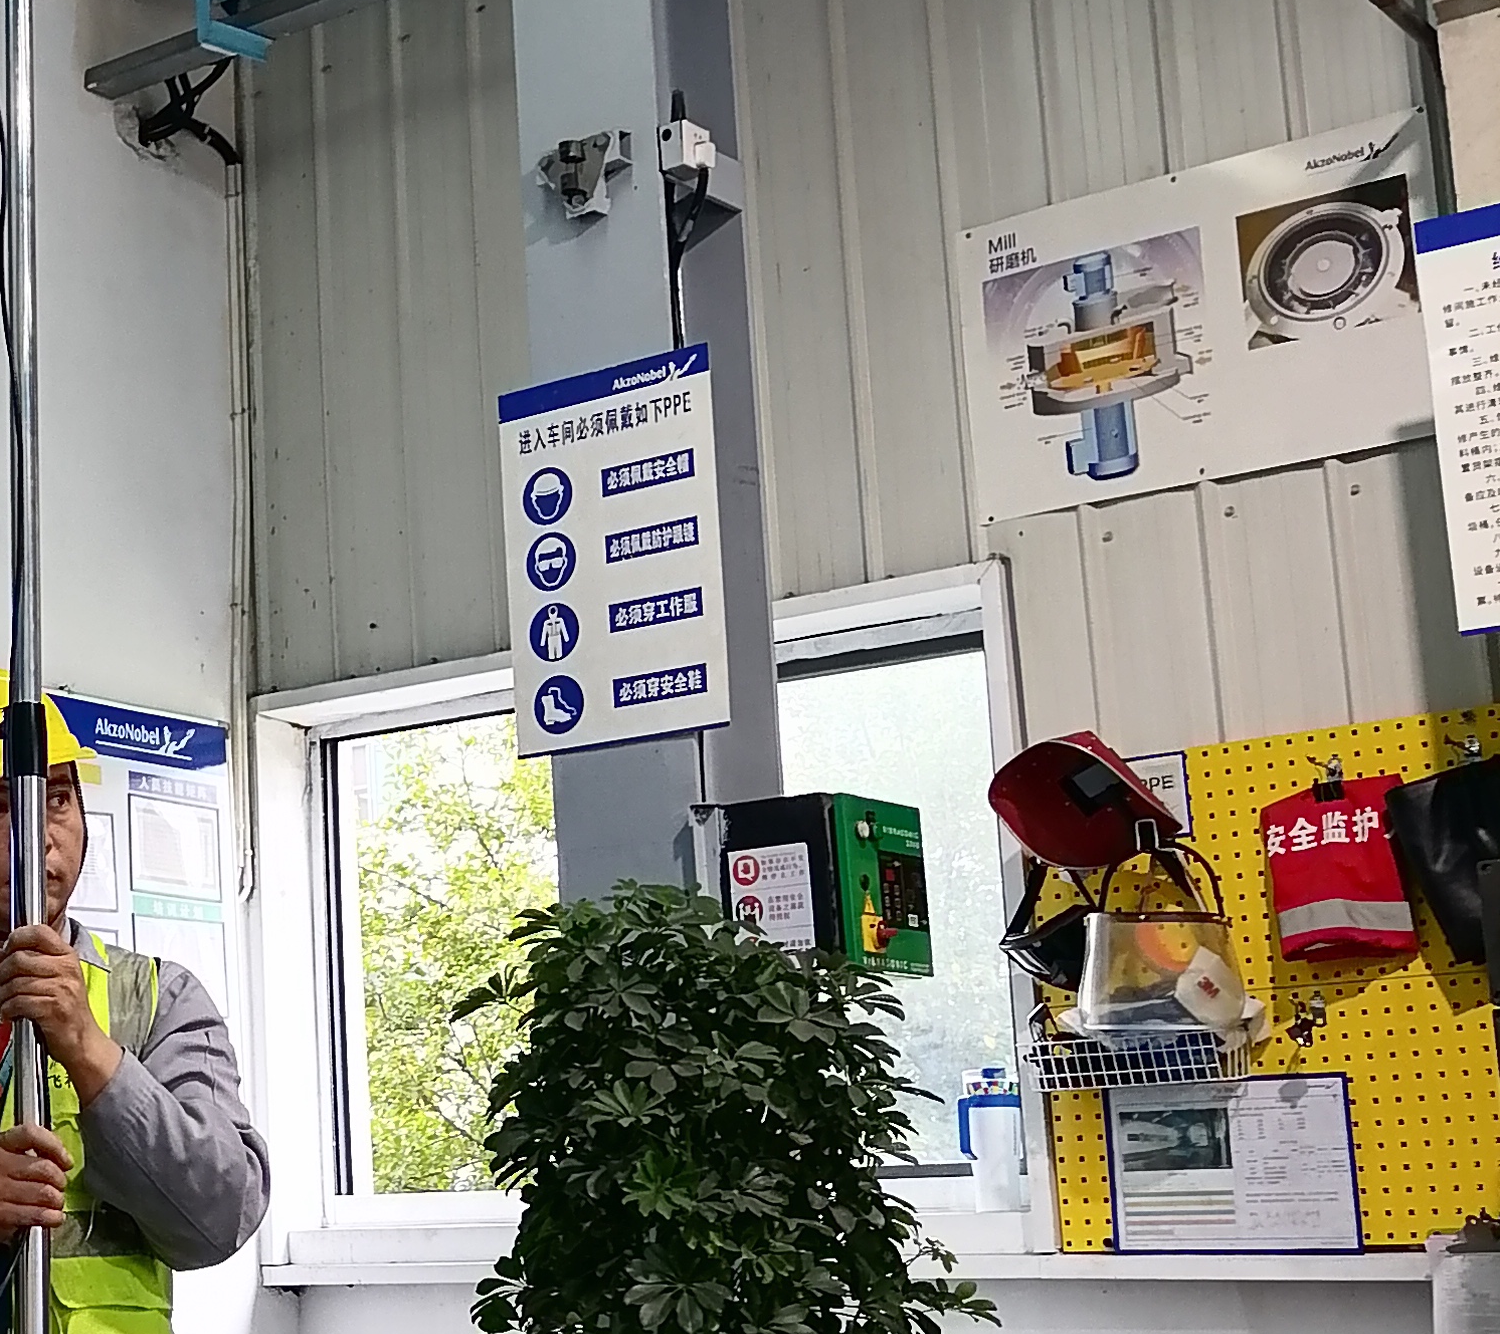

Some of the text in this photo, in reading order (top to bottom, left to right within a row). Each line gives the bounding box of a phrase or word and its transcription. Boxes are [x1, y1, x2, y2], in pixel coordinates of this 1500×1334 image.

[1304, 146, 1365, 171] AkzoNobel
[987, 232, 1017, 254] Mill
[988, 247, 1037, 273] 研磨机
[611, 366, 667, 391] AkzoNobel
[518, 391, 692, 455] 进入车间必须佩戴如下PPE
[615, 594, 698, 628] 必须穿工作服
[619, 669, 702, 701] 必须穿安全鞋
[95, 717, 161, 746] AkzoNobel
[1266, 806, 1393, 857] 安全监护
[1196, 975, 1220, 999] 3M
